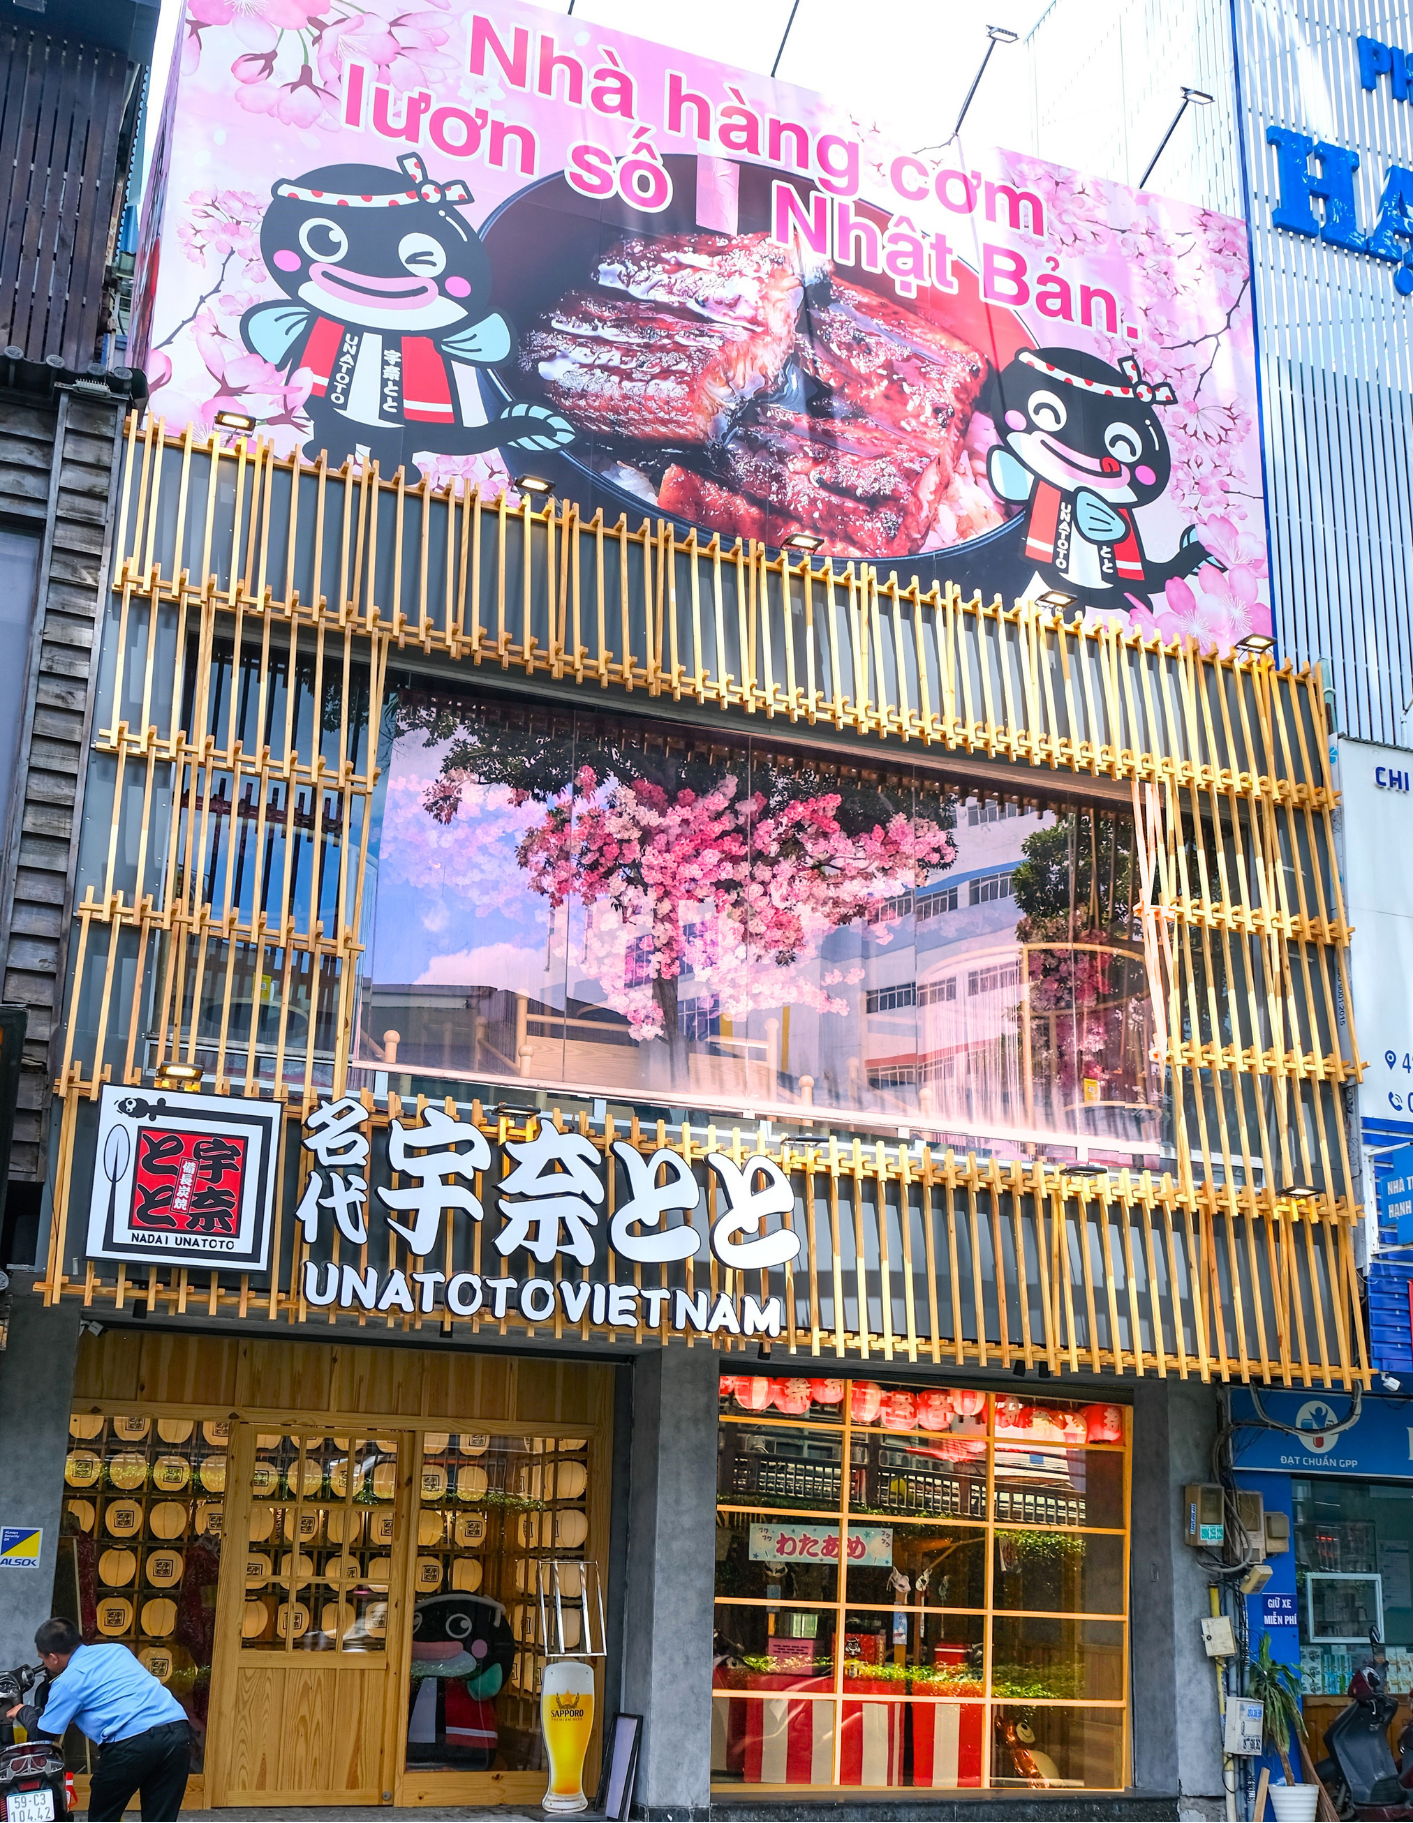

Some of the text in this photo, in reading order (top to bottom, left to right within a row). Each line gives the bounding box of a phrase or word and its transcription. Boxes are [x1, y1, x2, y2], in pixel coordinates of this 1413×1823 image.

[469, 14, 1045, 239] Nhà hàng cơm
[344, 63, 1139, 341] lươn số Nhật Bản.
[330, 333, 359, 405] UNATOTO
[1055, 501, 1072, 569] UNATOTO
[1375, 766, 1410, 791] CHI
[295, 1097, 370, 1246] 名代
[376, 1105, 802, 1270] 宇奈とと
[1387, 1176, 1406, 1196] NHÀ
[1388, 1199, 1413, 1220] HẠNH
[131, 1232, 236, 1250] NADAI UNATOTO
[1280, 1454, 1358, 1468] ĐẠT CHUẨN GPP
[0, 1558, 37, 1566] ALSOK
[1267, 1597, 1292, 1609] GIỮ XE
[1264, 1611, 1298, 1625] MIỄN PHÍ
[551, 1709, 584, 1717] SAPPORO
[14, 1793, 46, 1809] 59-C3
[11, 1806, 51, 1822] 104.42
